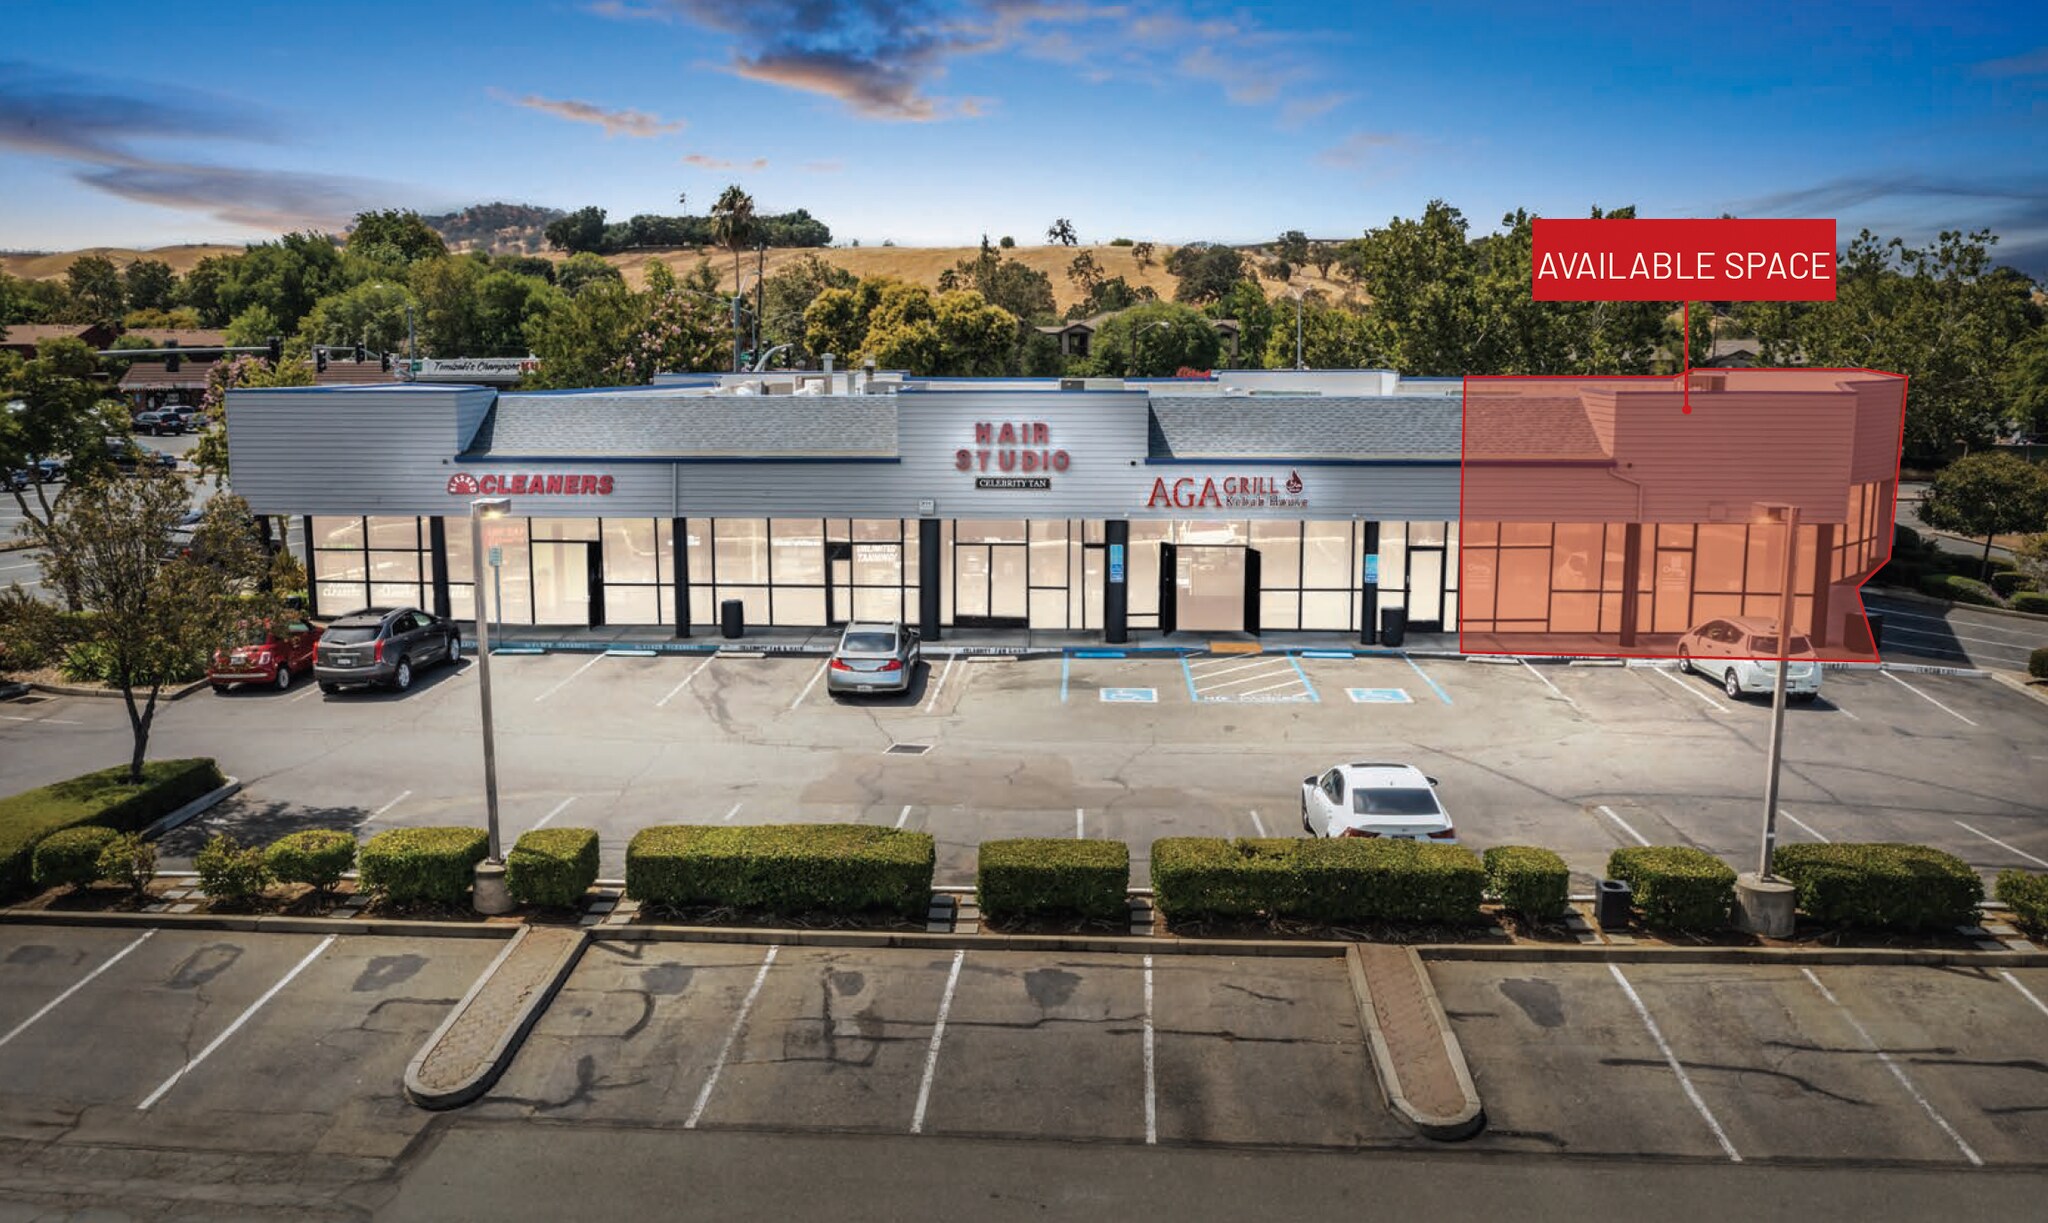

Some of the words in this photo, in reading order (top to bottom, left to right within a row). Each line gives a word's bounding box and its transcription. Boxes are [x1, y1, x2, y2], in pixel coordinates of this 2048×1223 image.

[975, 422, 1050, 445] HAIR
[955, 449, 1071, 473] STUDIO
[479, 474, 615, 495] CLEANERS
[979, 478, 1027, 488] CELEBRITY
[1028, 478, 1048, 488] TAN
[1146, 476, 1222, 509] AGA
[1222, 476, 1279, 495] GRILL
[1225, 495, 1265, 508] Kebab
[1268, 495, 1309, 509] House
